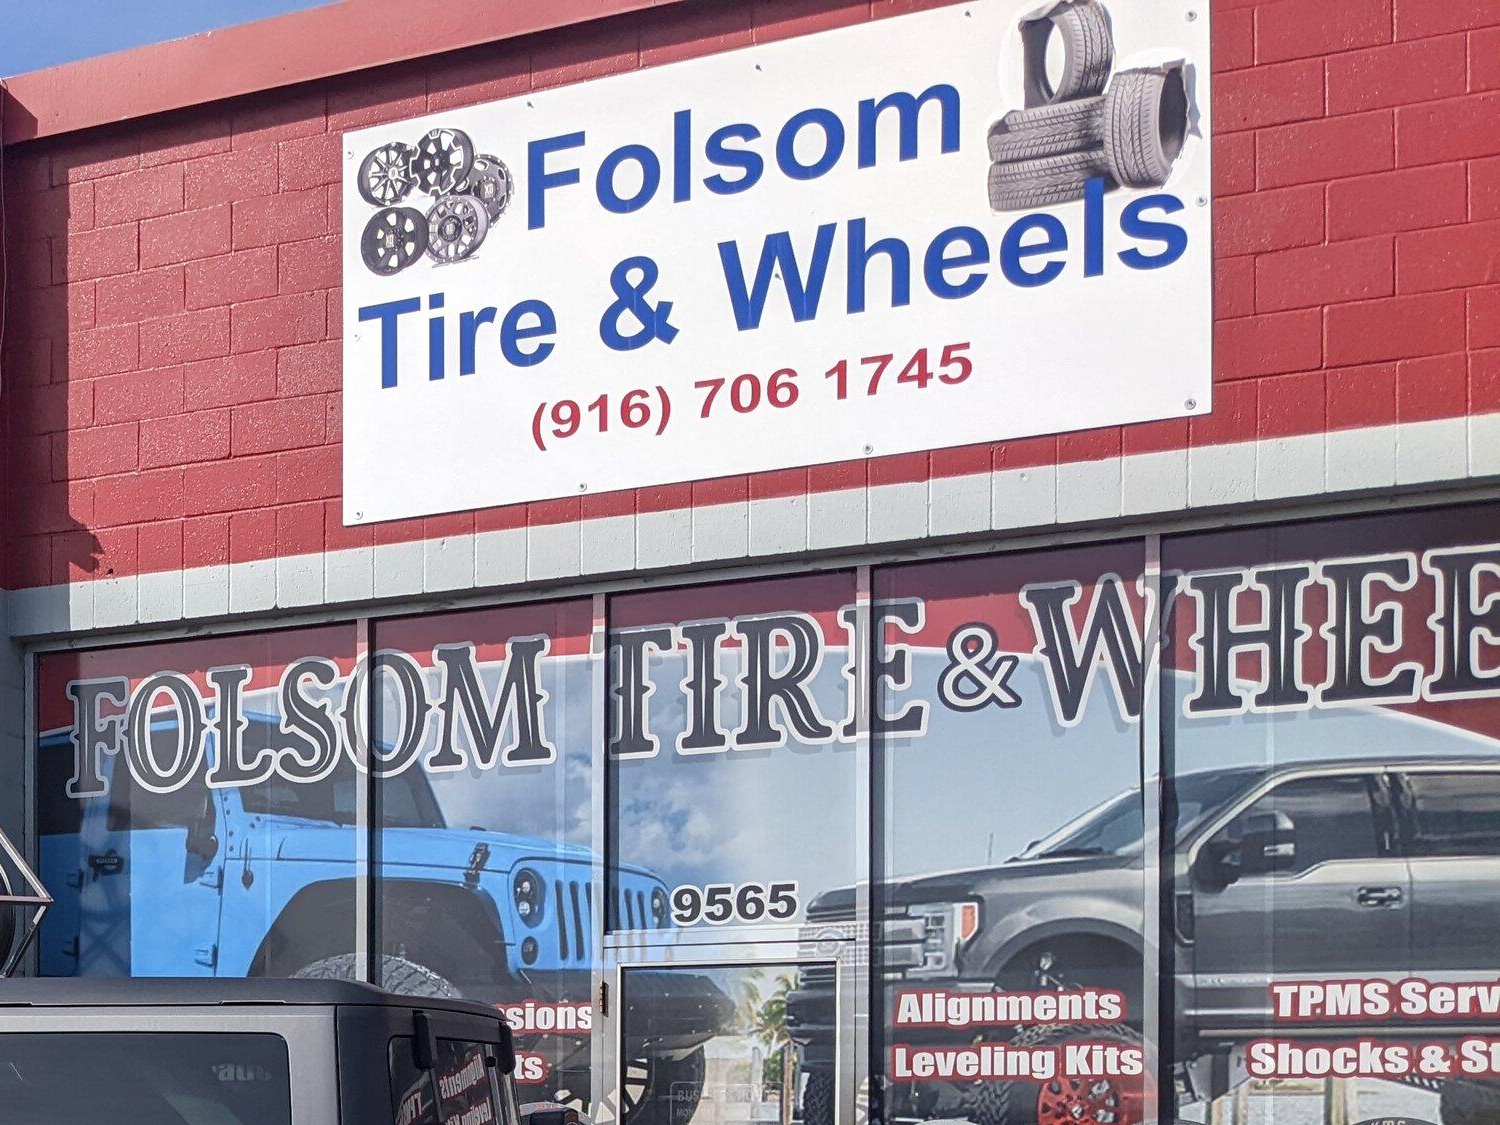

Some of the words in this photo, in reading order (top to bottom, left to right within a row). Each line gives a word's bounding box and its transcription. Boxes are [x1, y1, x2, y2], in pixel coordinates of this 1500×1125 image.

[526, 82, 963, 231] Folsom
[358, 291, 557, 391] Tire
[598, 254, 681, 353] &
[717, 177, 1190, 332] Wheels
[530, 384, 673, 453] (916)
[693, 366, 801, 420] 706
[825, 341, 974, 402] 1745
[66, 633, 557, 799] FOLSOM
[607, 596, 931, 760] TIRE
[937, 620, 1022, 713] &
[670, 882, 798, 927] 9565
[498, 1002, 592, 1031] sions
[896, 990, 1122, 1026] Alignments
[1273, 982, 1390, 1018] TPMS
[894, 1045, 1056, 1081] Leveling
[1064, 1044, 1144, 1076] Kits
[1250, 1041, 1410, 1076] Shocks
[1418, 1045, 1451, 1074] &
